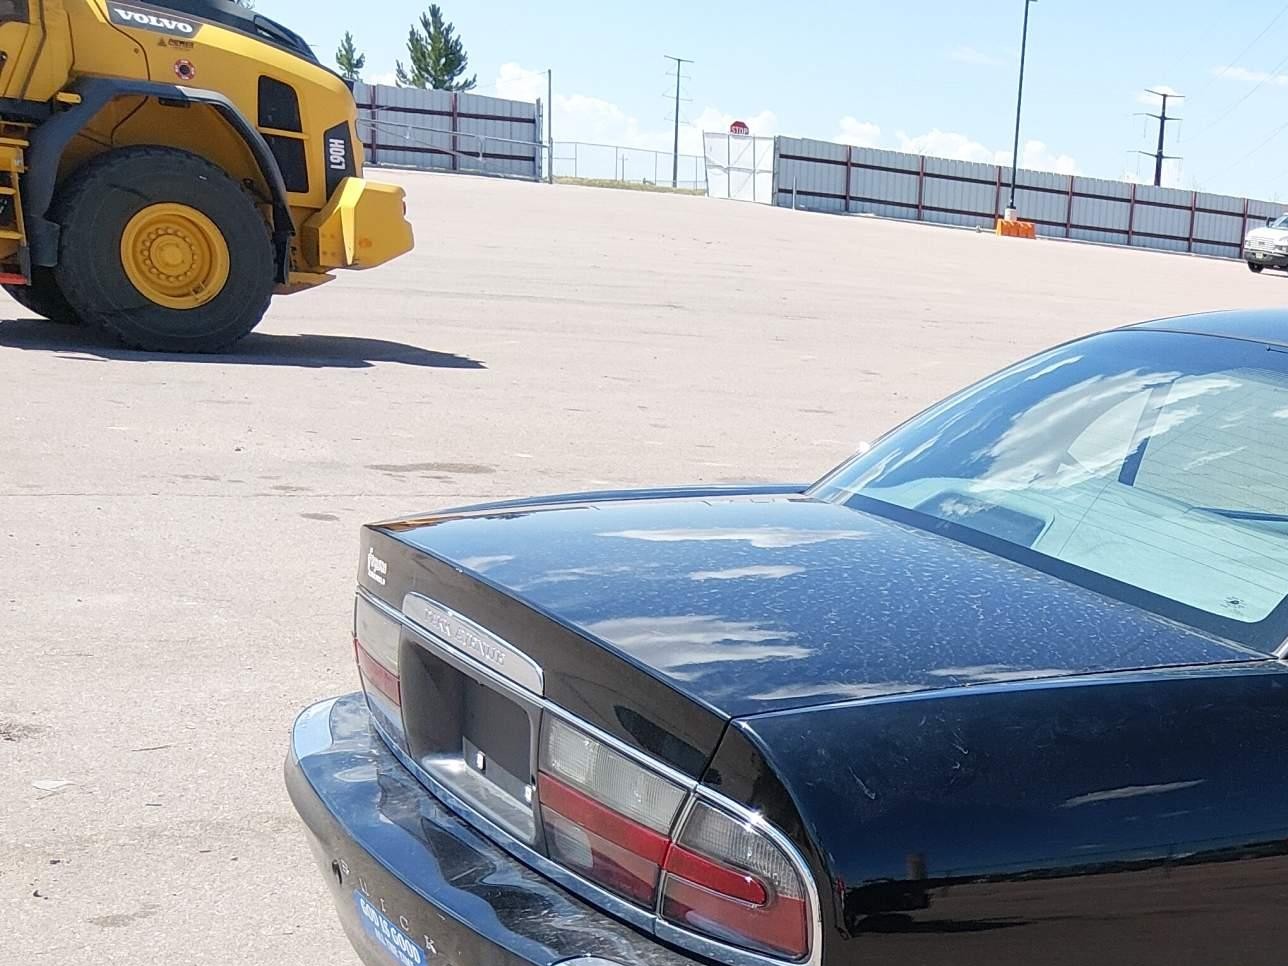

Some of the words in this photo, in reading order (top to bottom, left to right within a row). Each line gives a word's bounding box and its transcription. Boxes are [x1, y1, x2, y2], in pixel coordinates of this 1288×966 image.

[114, 8, 193, 33] VOLVO
[731, 126, 749, 135] STOP
[329, 138, 346, 170] L90H
[390, 926, 421, 965] GOOD
